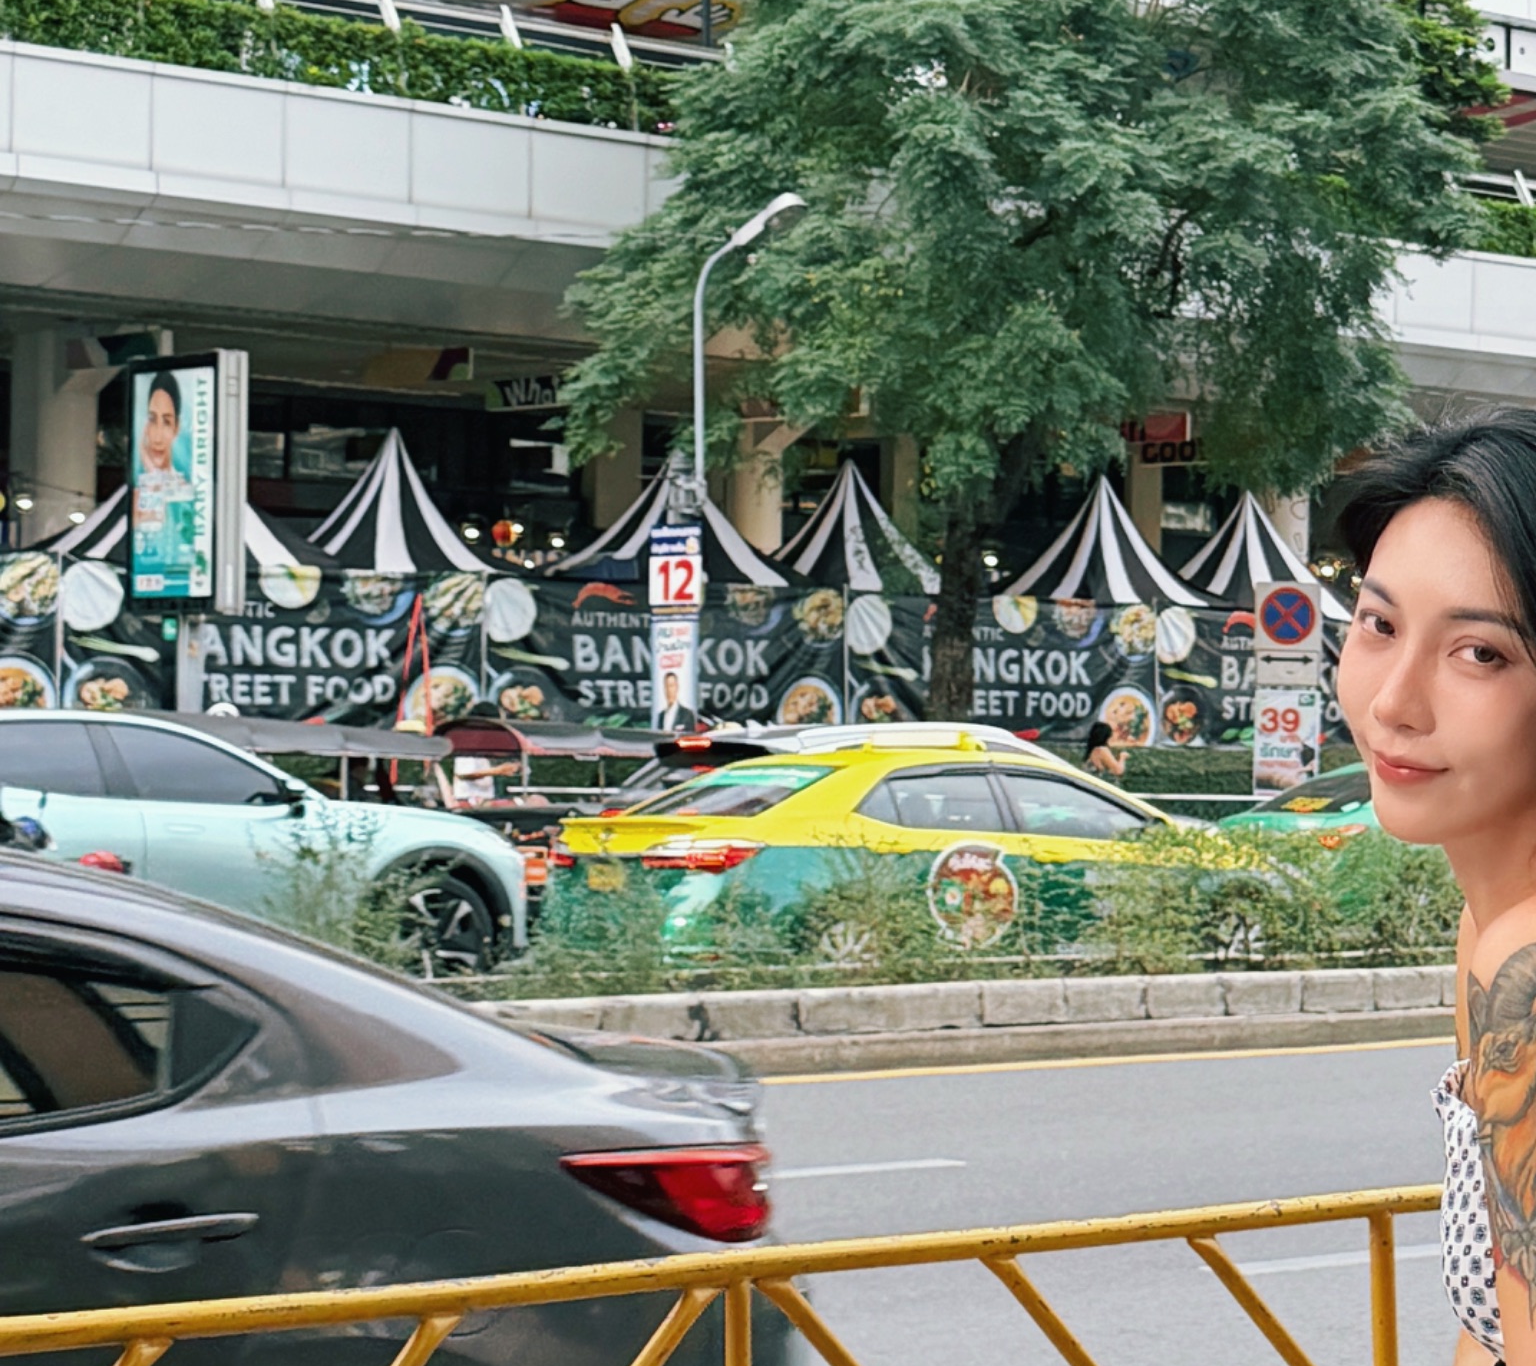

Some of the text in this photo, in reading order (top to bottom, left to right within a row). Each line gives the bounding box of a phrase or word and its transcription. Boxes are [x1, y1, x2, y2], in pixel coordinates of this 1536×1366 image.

[658, 559, 694, 602] 12
[571, 611, 650, 628] AUTHENT
[203, 624, 396, 668] ANGKOK
[572, 634, 770, 676] BANKOK
[202, 673, 397, 706] REET FOOD
[578, 679, 652, 708] STRE
[1025, 691, 1092, 718] FOOD
[1260, 708, 1300, 734] 39
